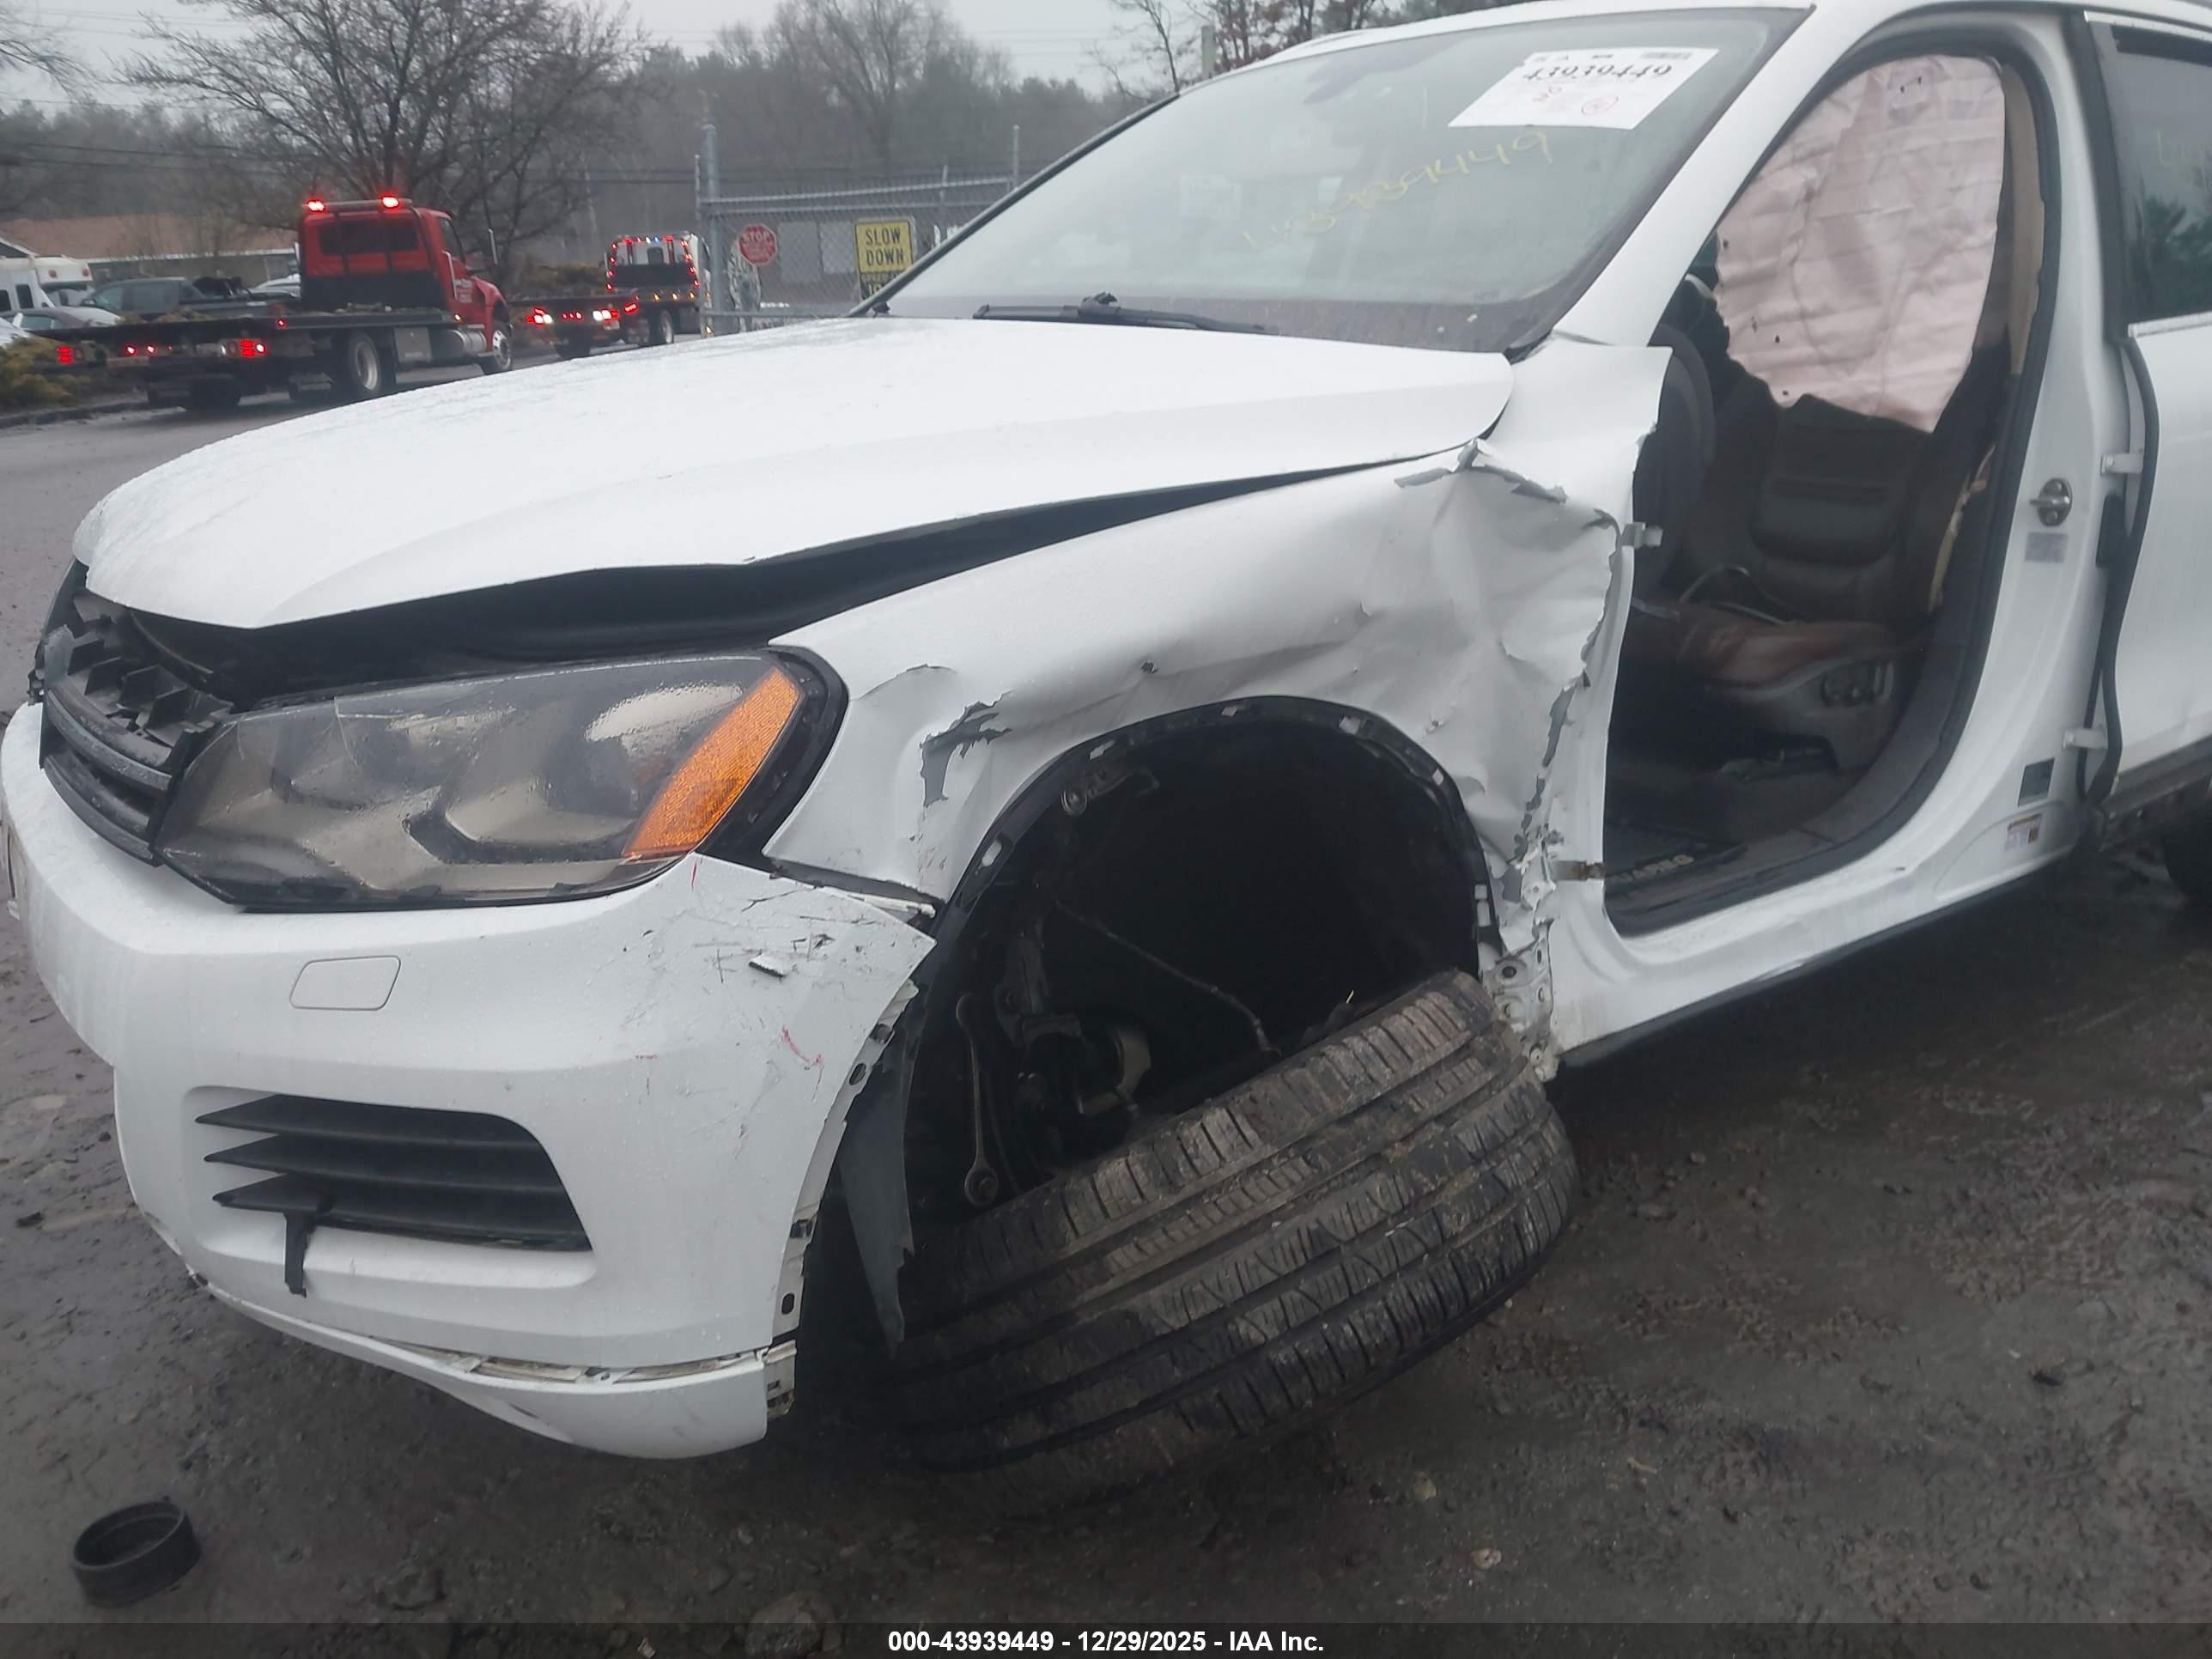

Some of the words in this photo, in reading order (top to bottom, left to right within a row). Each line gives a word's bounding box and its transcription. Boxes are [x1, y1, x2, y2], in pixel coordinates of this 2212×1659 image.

[742, 230, 769, 242] STOP
[866, 227, 901, 246] SLOW
[866, 247, 904, 266] DOWN
